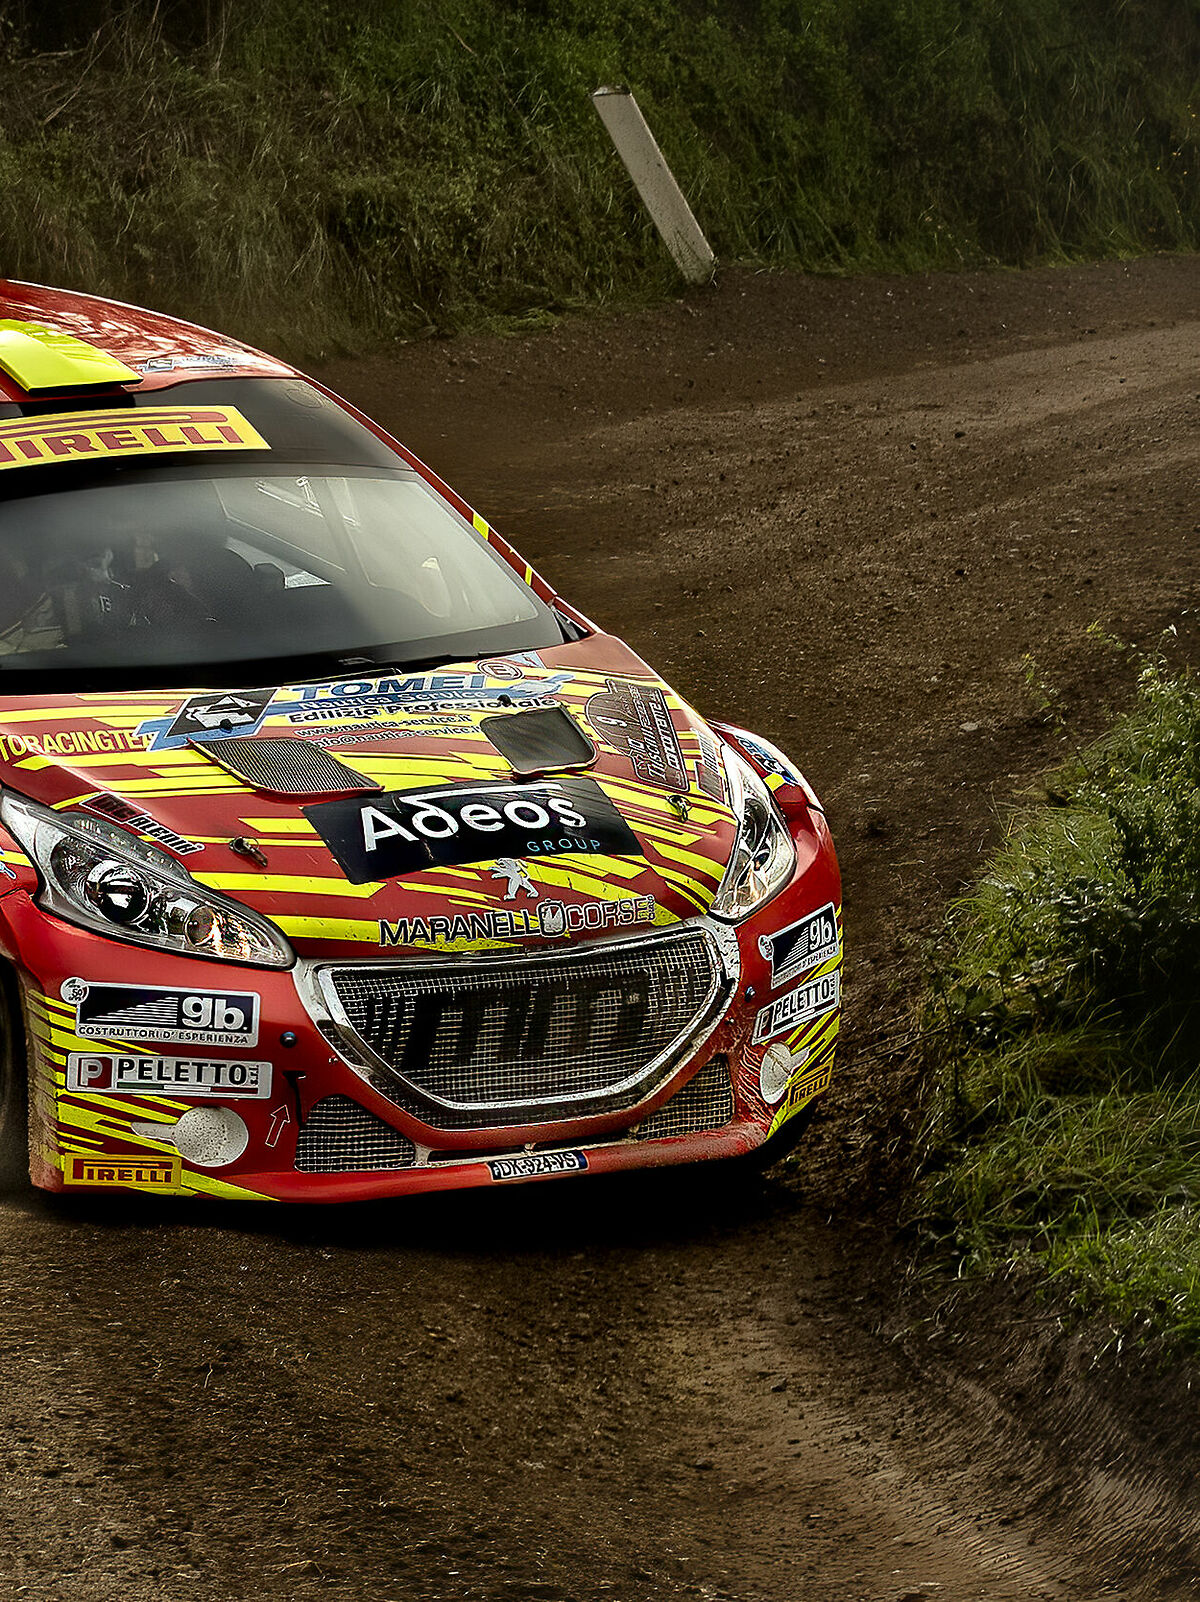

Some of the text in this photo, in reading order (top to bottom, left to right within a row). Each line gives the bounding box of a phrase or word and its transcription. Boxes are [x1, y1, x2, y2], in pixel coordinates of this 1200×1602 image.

[297, 673, 487, 701] TOMEI
[300, 689, 489, 710] Nautica Service
[288, 697, 558, 724] Edilizia Professionale
[527, 838, 601, 852] GROUP
[774, 978, 830, 1023] PELETTO
[79, 1026, 160, 1039] COSTRUTTORI
[178, 1032, 249, 1044] ESPERIENZA
[80, 1058, 103, 1087] P
[117, 1057, 248, 1086] PELETTO
[789, 1065, 831, 1107] PIRELLI
[72, 1158, 174, 1183] PIRELLI
